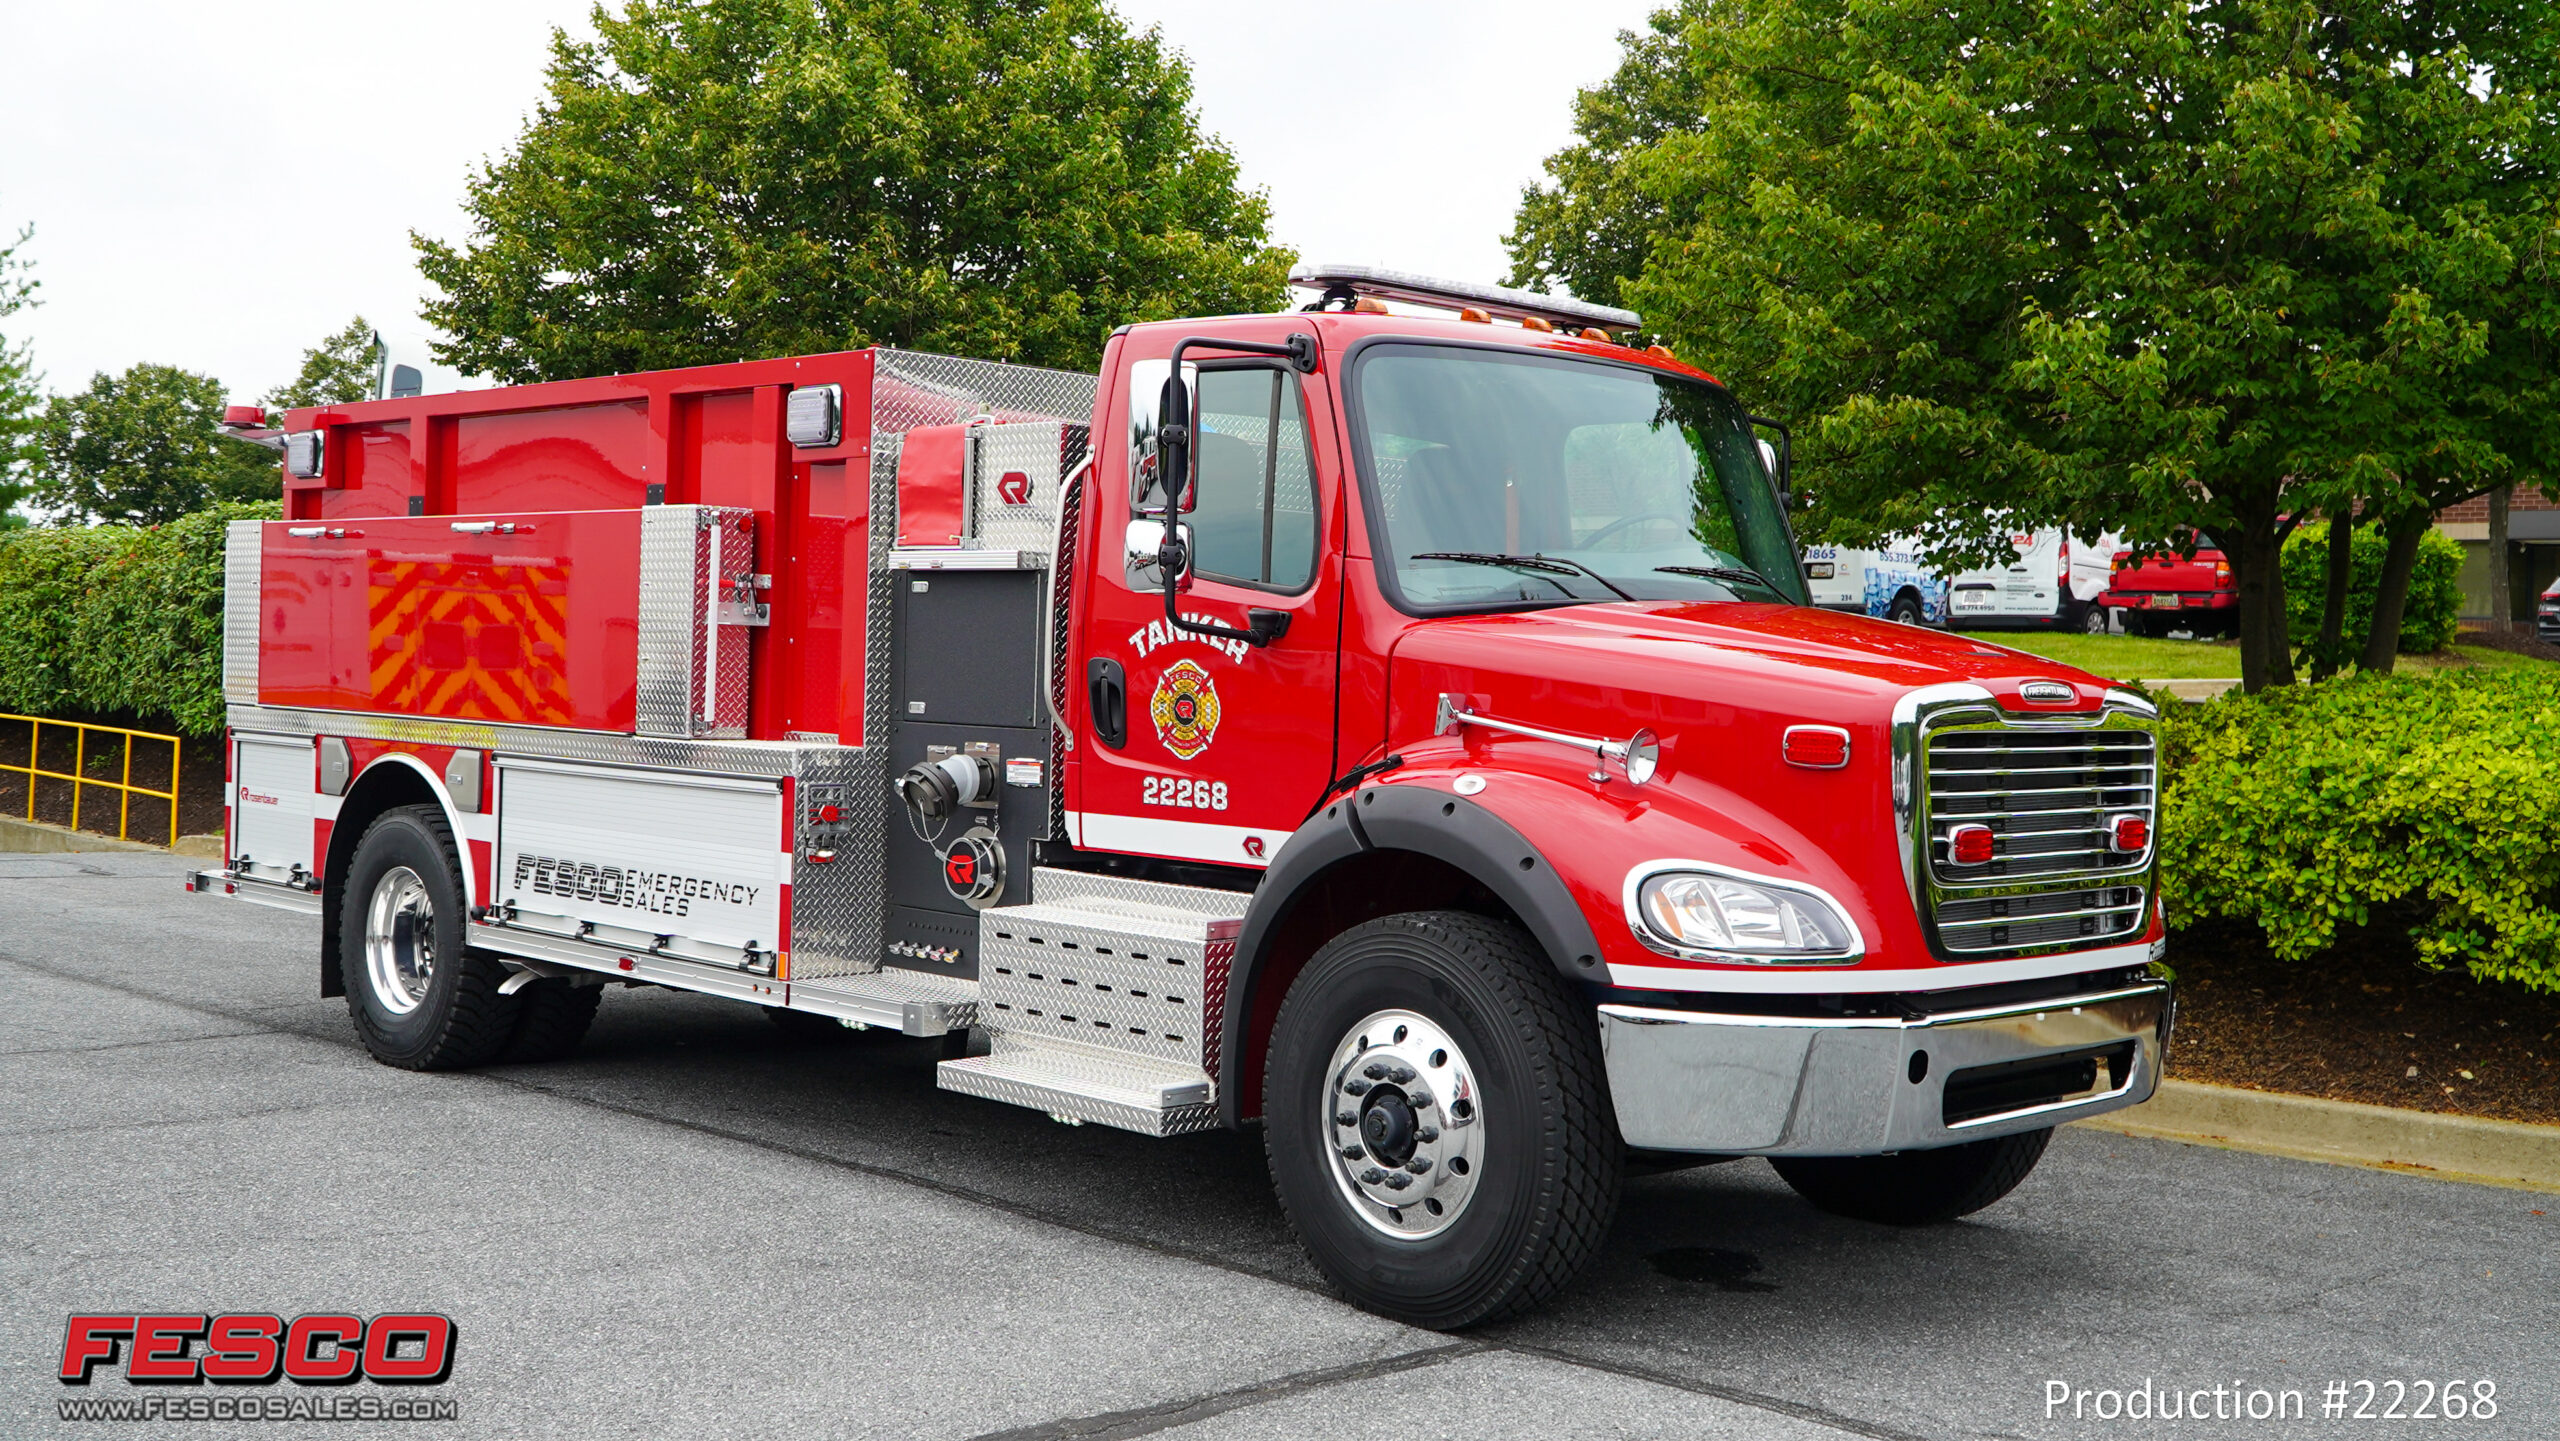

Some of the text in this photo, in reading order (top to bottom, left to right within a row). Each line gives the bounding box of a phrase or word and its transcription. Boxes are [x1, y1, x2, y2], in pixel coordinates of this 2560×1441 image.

[2013, 535, 2033, 547] 24
[1128, 612, 1250, 665] TANKER
[1169, 671, 1203, 684] FESCO
[1142, 776, 1229, 811] 22268
[513, 853, 760, 907] FESCO EMERGENCY
[622, 889, 690, 918] SALES
